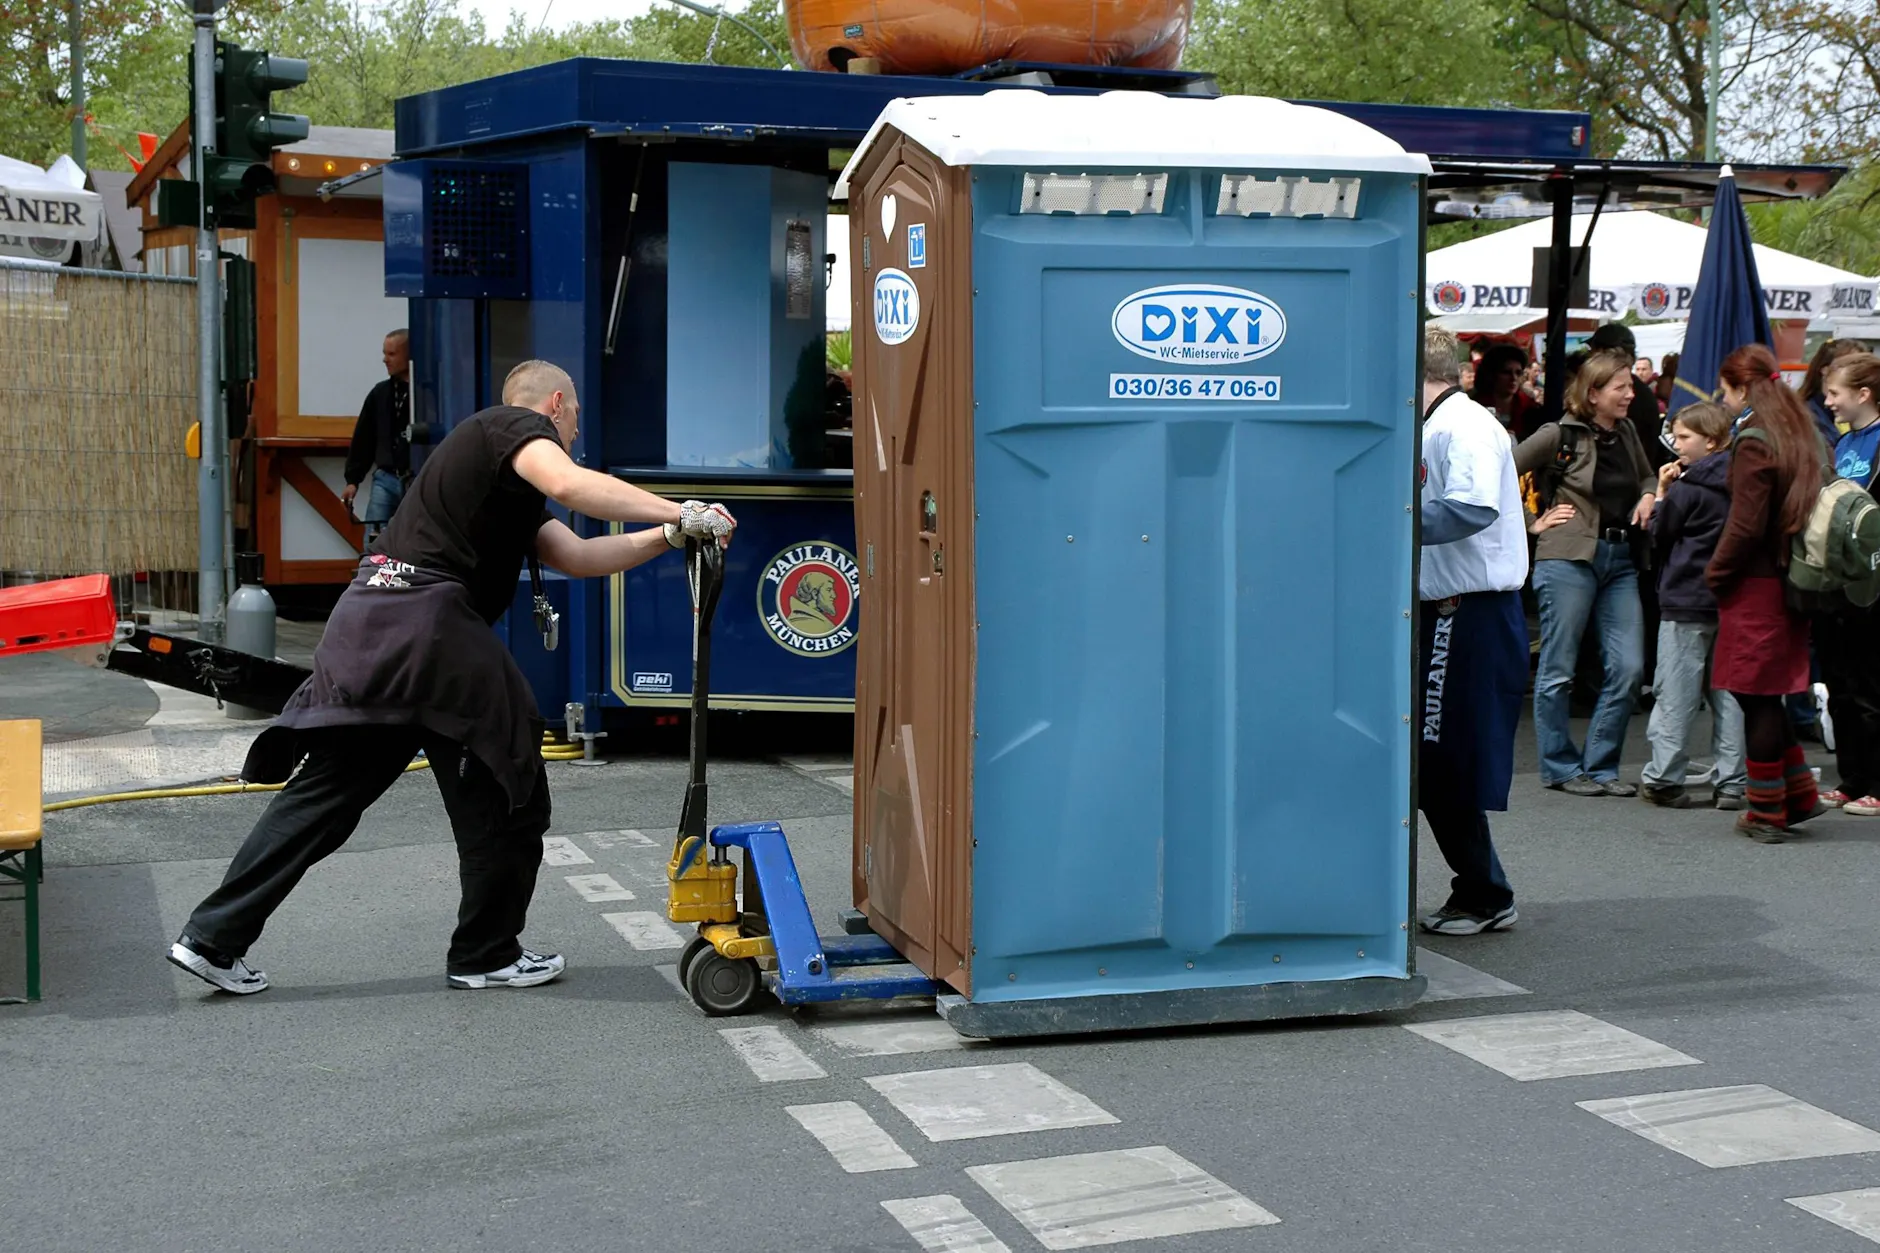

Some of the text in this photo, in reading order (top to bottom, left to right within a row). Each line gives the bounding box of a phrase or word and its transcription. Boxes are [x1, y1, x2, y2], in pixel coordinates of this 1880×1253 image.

[1160, 346, 1240, 360] WC-Mietservice
[1114, 378, 1277, 397] 030/36 47 06-0
[766, 612, 853, 651] MÜNCHEN
[636, 673, 669, 687] peki
[1423, 616, 1454, 744] PAULANER
